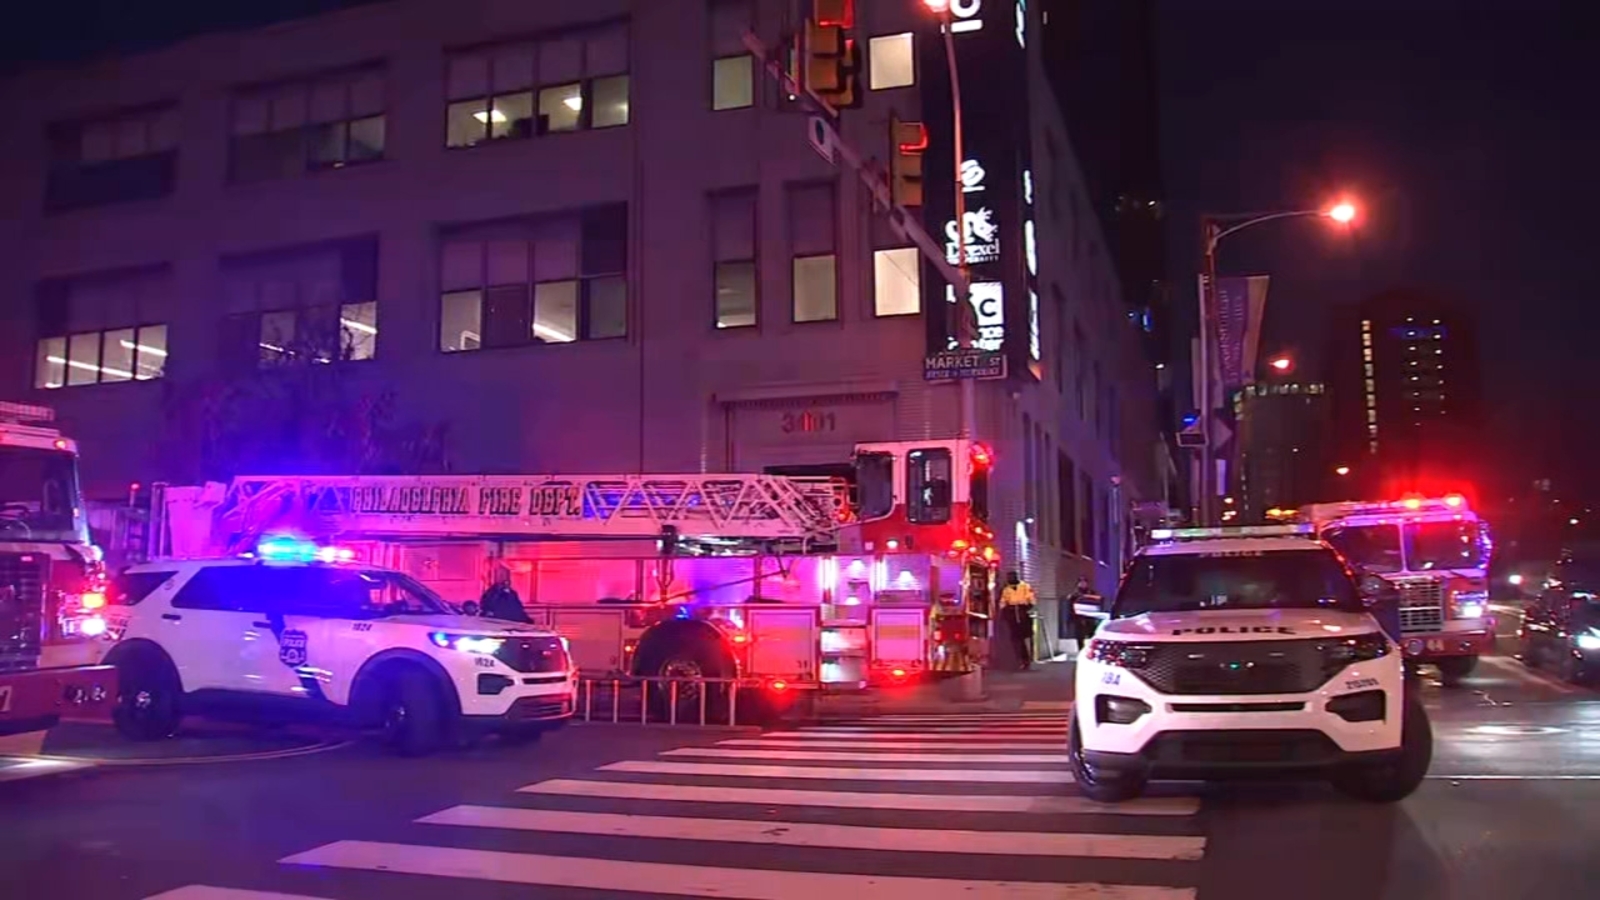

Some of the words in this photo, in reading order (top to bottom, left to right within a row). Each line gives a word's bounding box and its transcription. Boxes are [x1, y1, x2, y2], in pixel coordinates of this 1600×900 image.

[925, 355, 981, 369] MARKET
[989, 357, 1001, 366] ST
[352, 486, 470, 514] PHILADELPHIA
[478, 486, 522, 515] FIRE
[1171, 626, 1297, 636] POLICE
